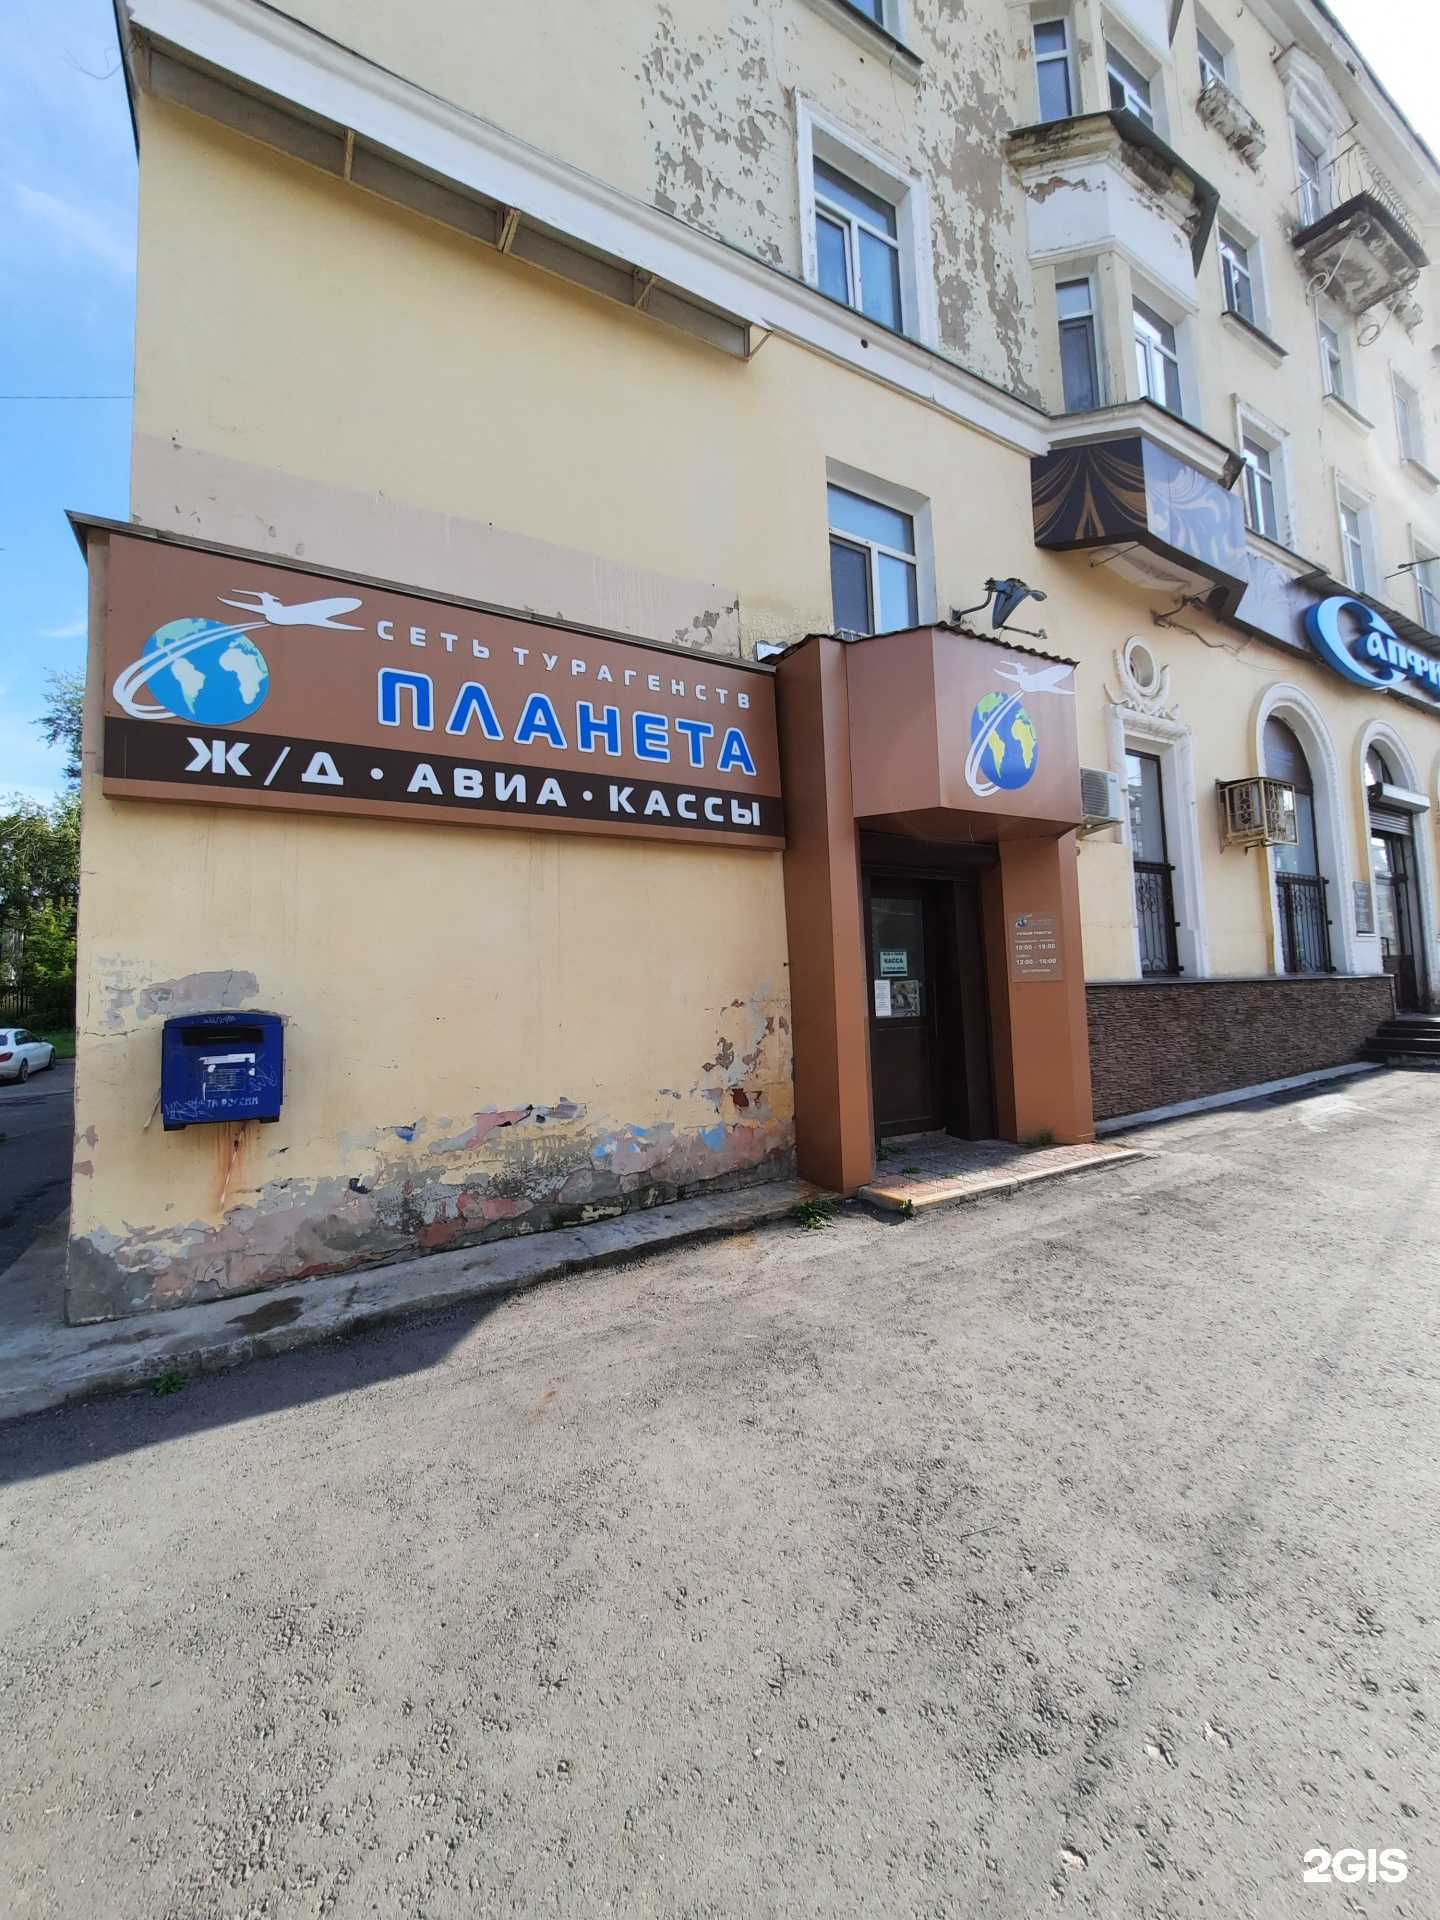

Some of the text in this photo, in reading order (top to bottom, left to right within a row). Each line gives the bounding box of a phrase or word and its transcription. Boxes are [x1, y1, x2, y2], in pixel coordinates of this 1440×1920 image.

[376, 620, 750, 709] СЕТЬ ТУРАГЕНСТВ
[377, 666, 757, 776] ПЛАНЕТА
[184, 737, 761, 826] Ж/Д АВИА КАССЫ
